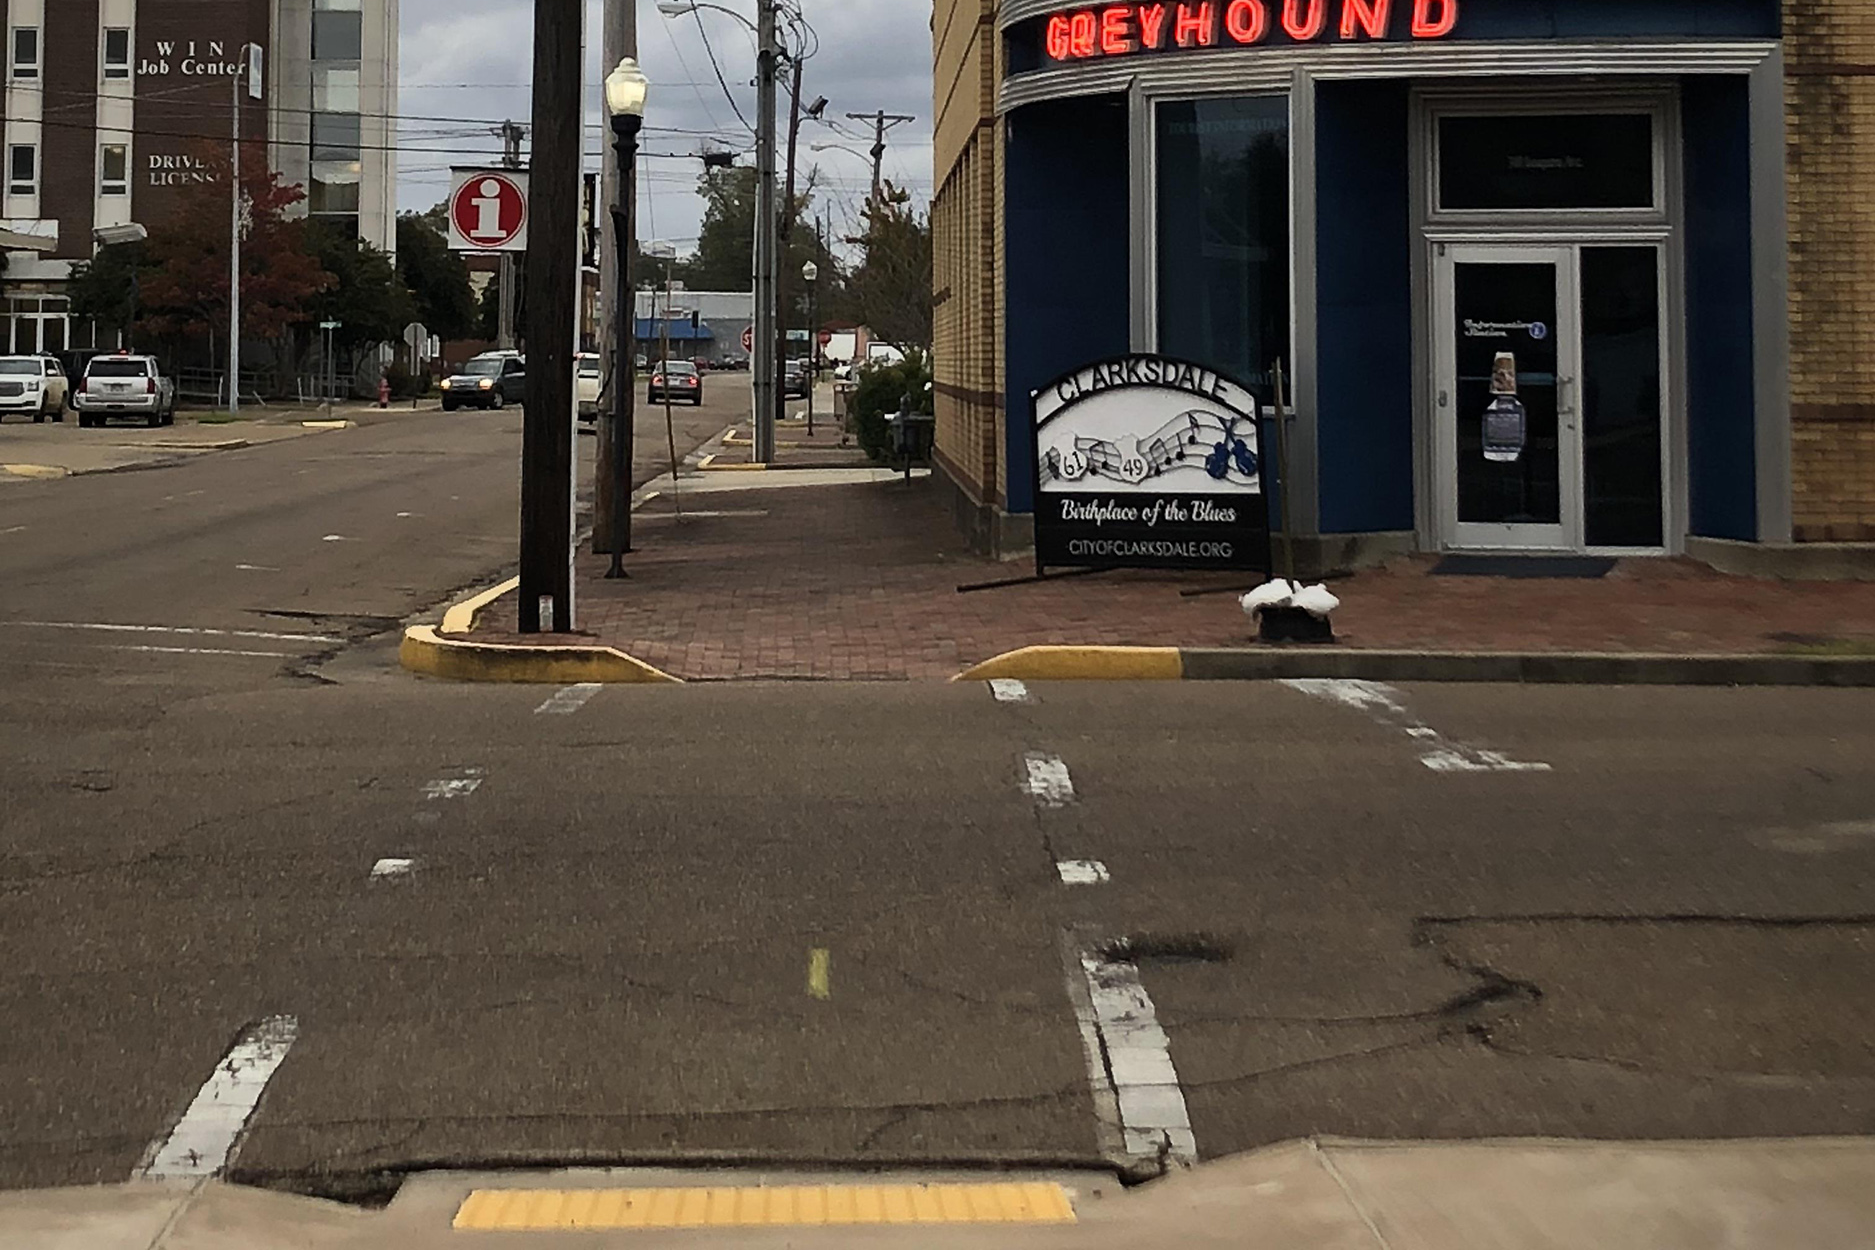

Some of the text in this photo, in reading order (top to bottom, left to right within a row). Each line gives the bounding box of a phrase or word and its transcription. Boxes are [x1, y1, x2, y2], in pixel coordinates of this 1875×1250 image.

[137, 59, 246, 75] Job Center
[1056, 358, 1229, 403] CLARKSDALE
[1063, 451, 1084, 477] 61
[1122, 458, 1144, 477] 49
[1061, 499, 1236, 527] Birthplace of the Blues
[1069, 539, 1233, 558] CITYOFCLARKSDALE.ORG
